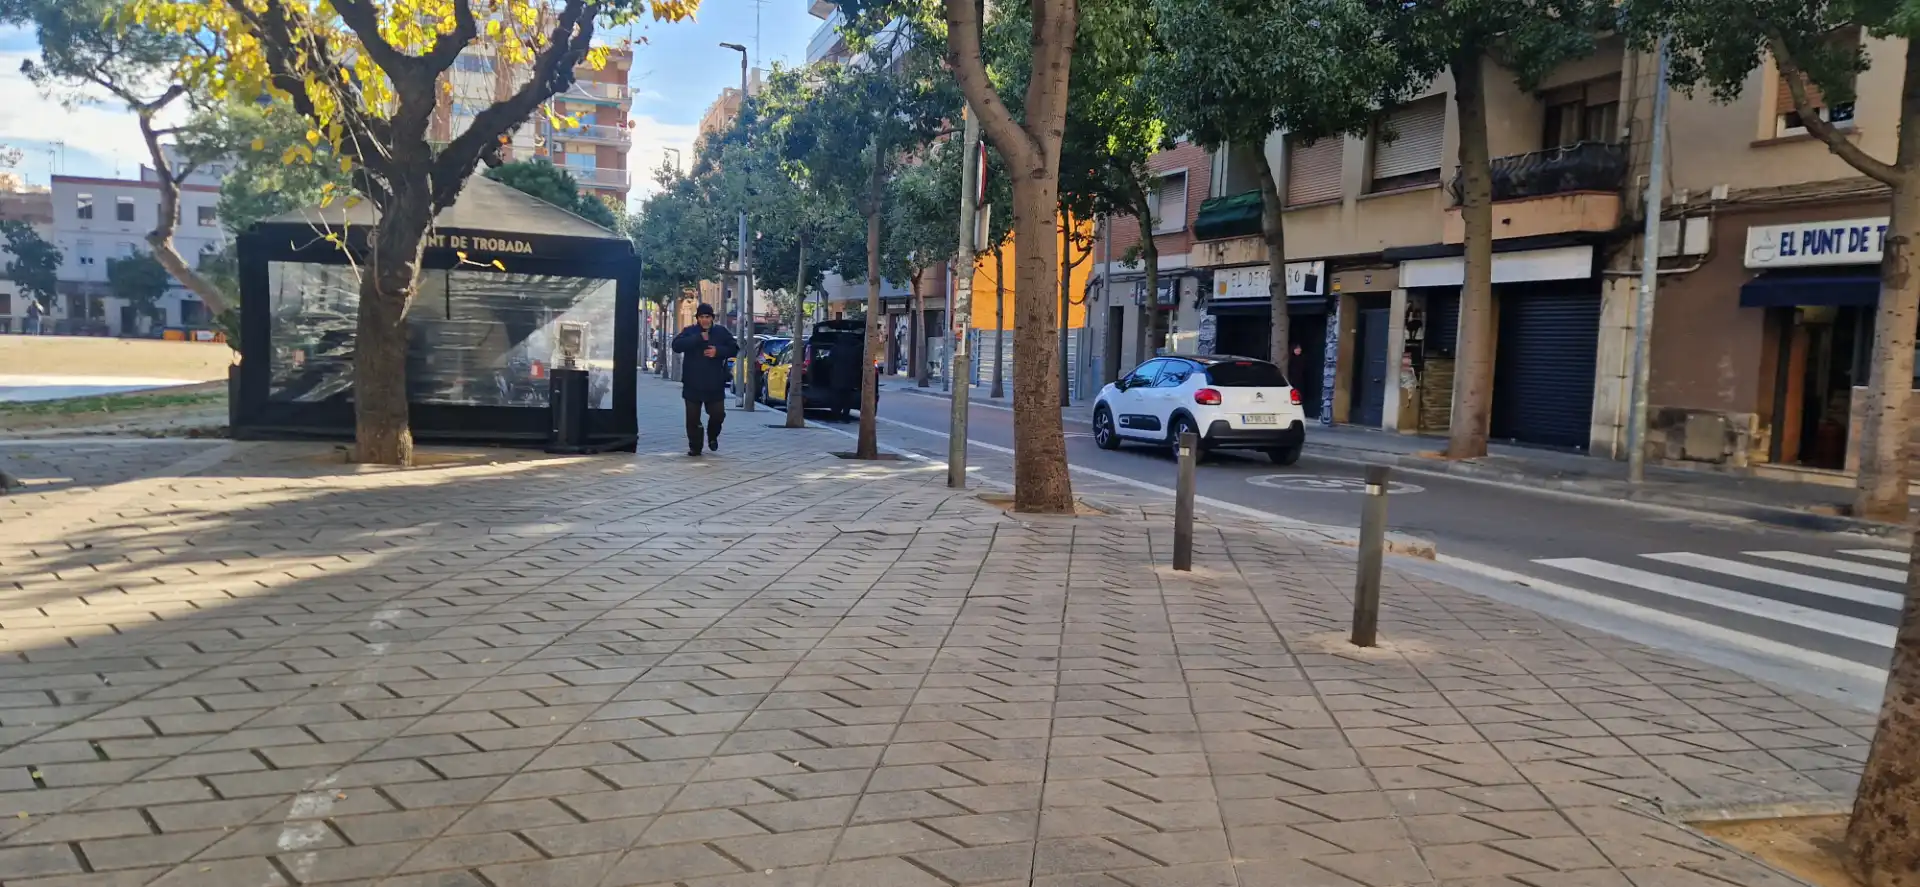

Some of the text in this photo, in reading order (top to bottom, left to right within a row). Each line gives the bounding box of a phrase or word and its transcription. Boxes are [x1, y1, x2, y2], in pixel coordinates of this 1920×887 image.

[451, 237, 468, 249] DE
[473, 237, 532, 253] TROBADA
[1780, 225, 1889, 256] EL PUNT DE T
